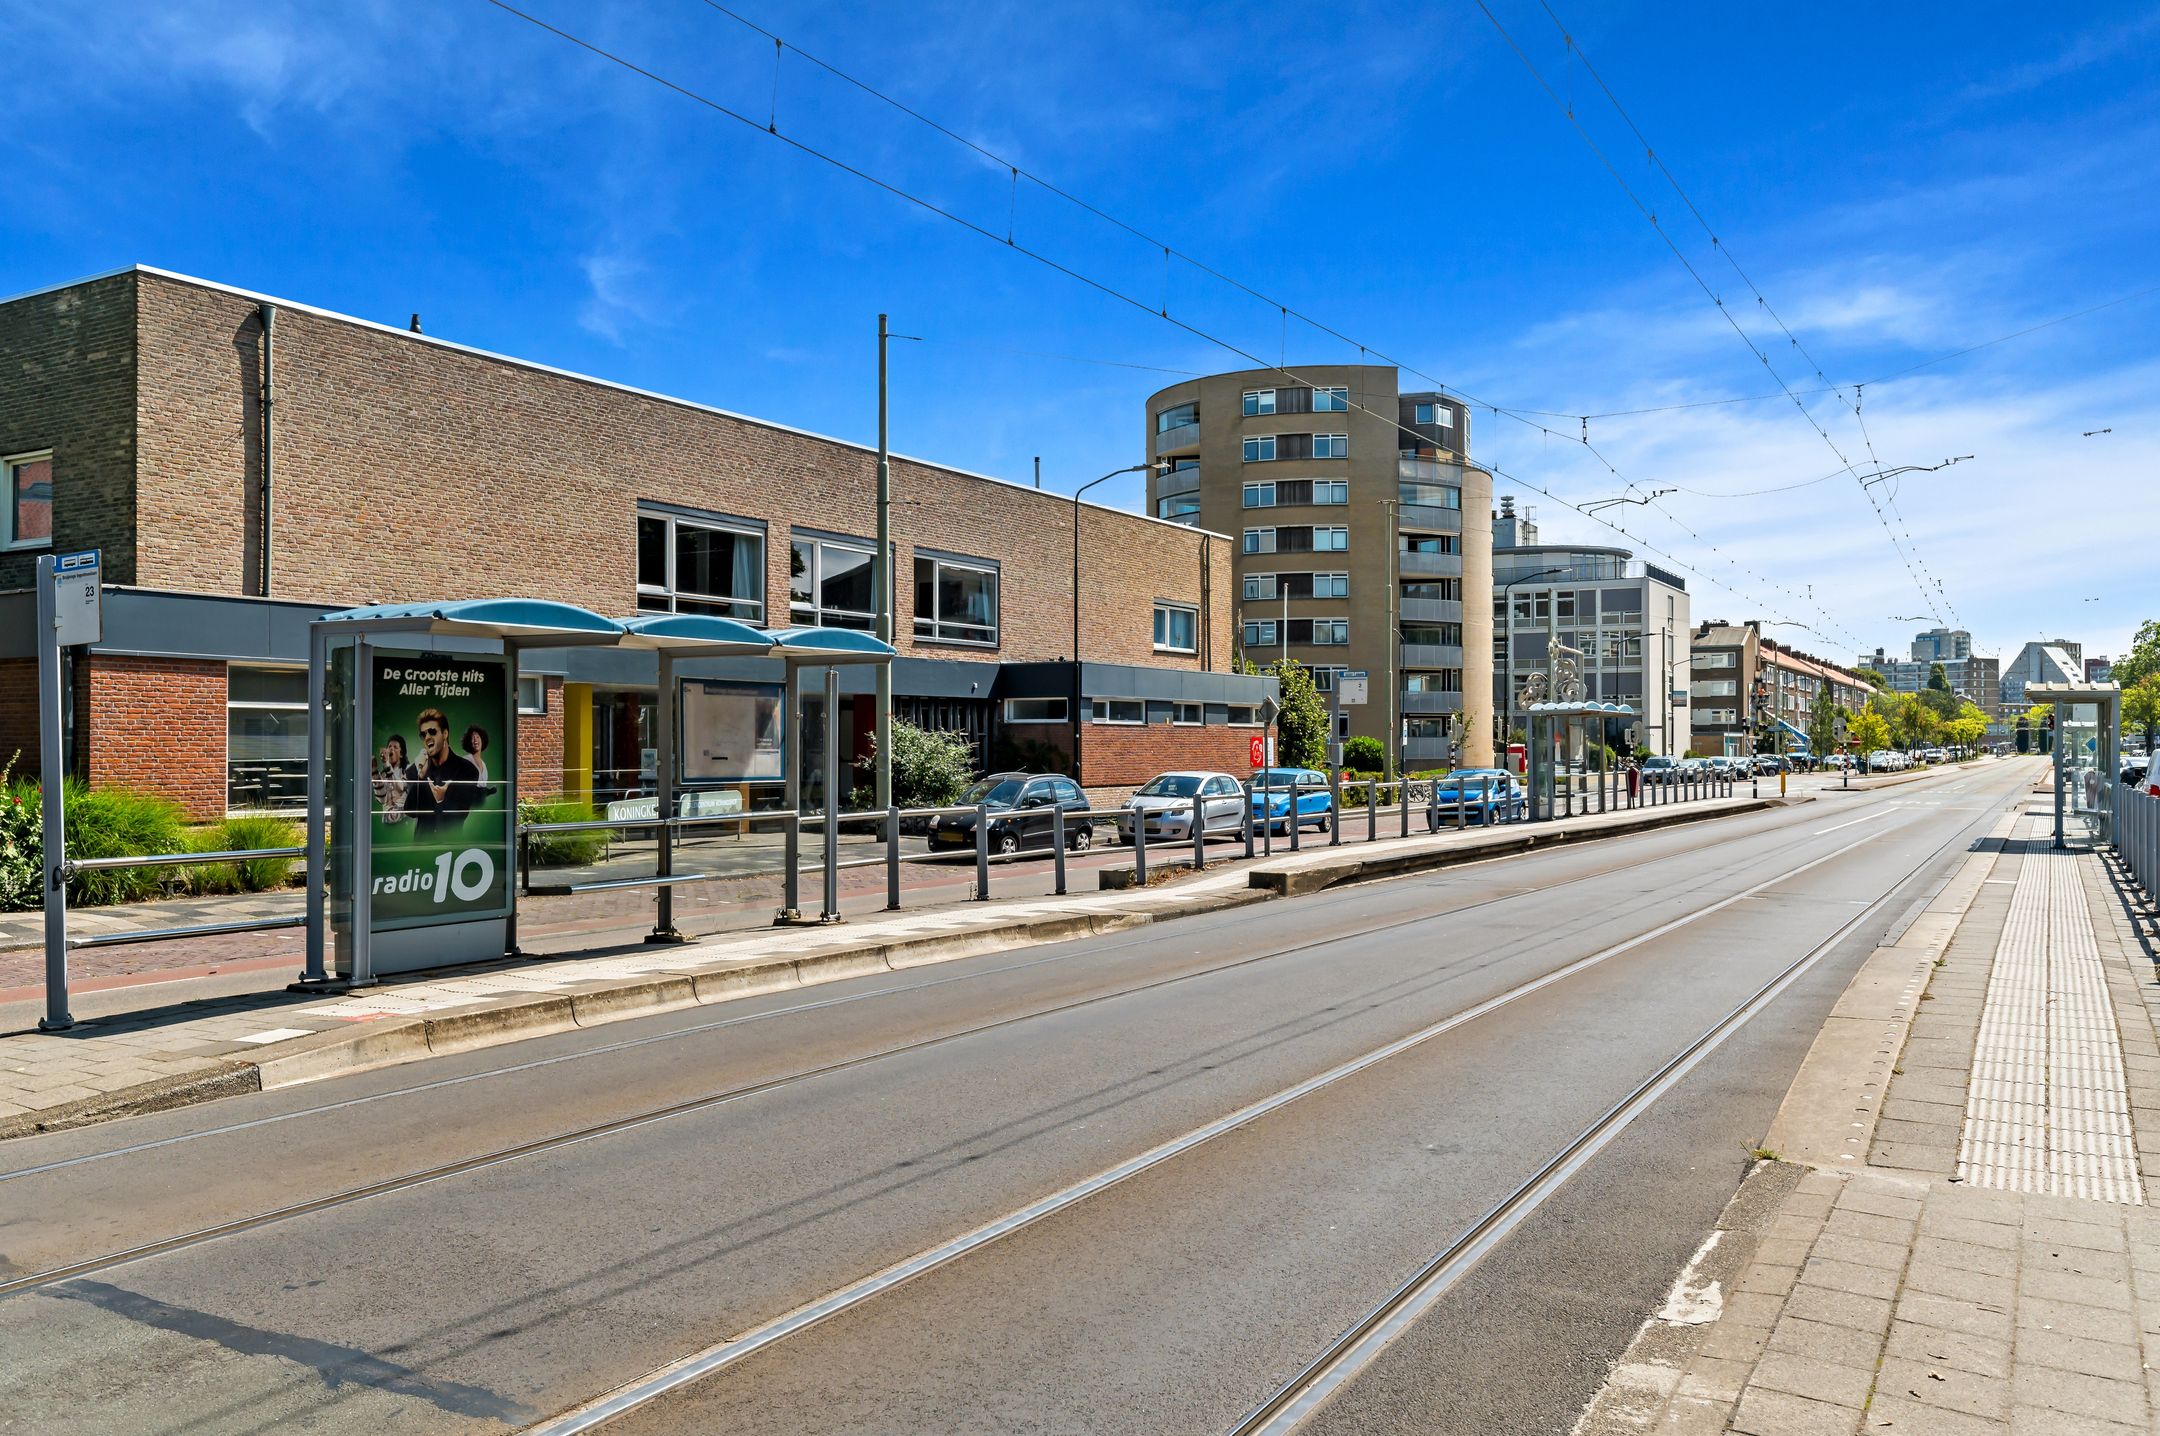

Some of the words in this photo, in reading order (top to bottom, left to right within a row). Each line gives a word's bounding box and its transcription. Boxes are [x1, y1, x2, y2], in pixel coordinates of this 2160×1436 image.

[85, 586, 95, 597] 23
[383, 668, 401, 680] De
[404, 669, 459, 682] Grootste
[461, 669, 485, 683] Hits
[399, 683, 430, 696] Aller
[433, 684, 470, 698] Tijden
[372, 868, 434, 895] radio
[433, 848, 495, 903] 10
